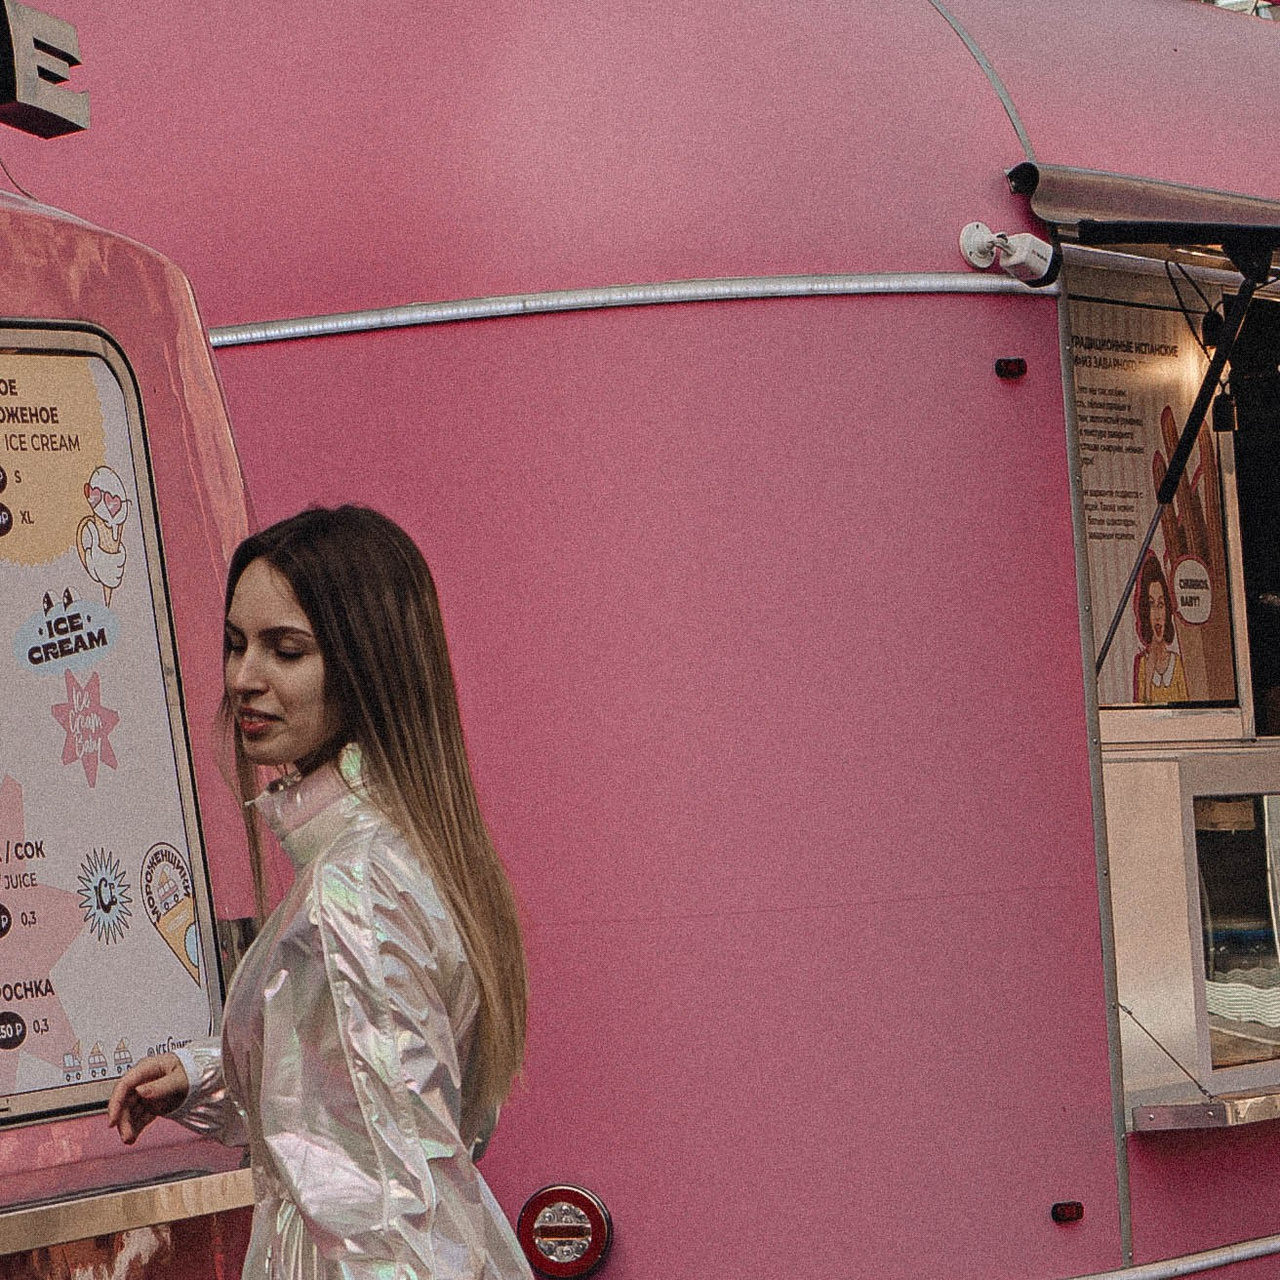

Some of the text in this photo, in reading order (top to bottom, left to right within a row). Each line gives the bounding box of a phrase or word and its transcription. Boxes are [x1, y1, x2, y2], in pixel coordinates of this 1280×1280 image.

[5, 434, 28, 451] ICE
[31, 434, 81, 451] CREAM
[21, 511, 35, 525] XL
[45, 613, 84, 639] ICE
[27, 627, 108, 665] CREAM
[14, 840, 46, 861] СОК
[4, 872, 39, 891] JUICE
[93, 876, 118, 914] ICE
[21, 910, 37, 928] 0,3
[32, 1018, 50, 1036] 0,3
